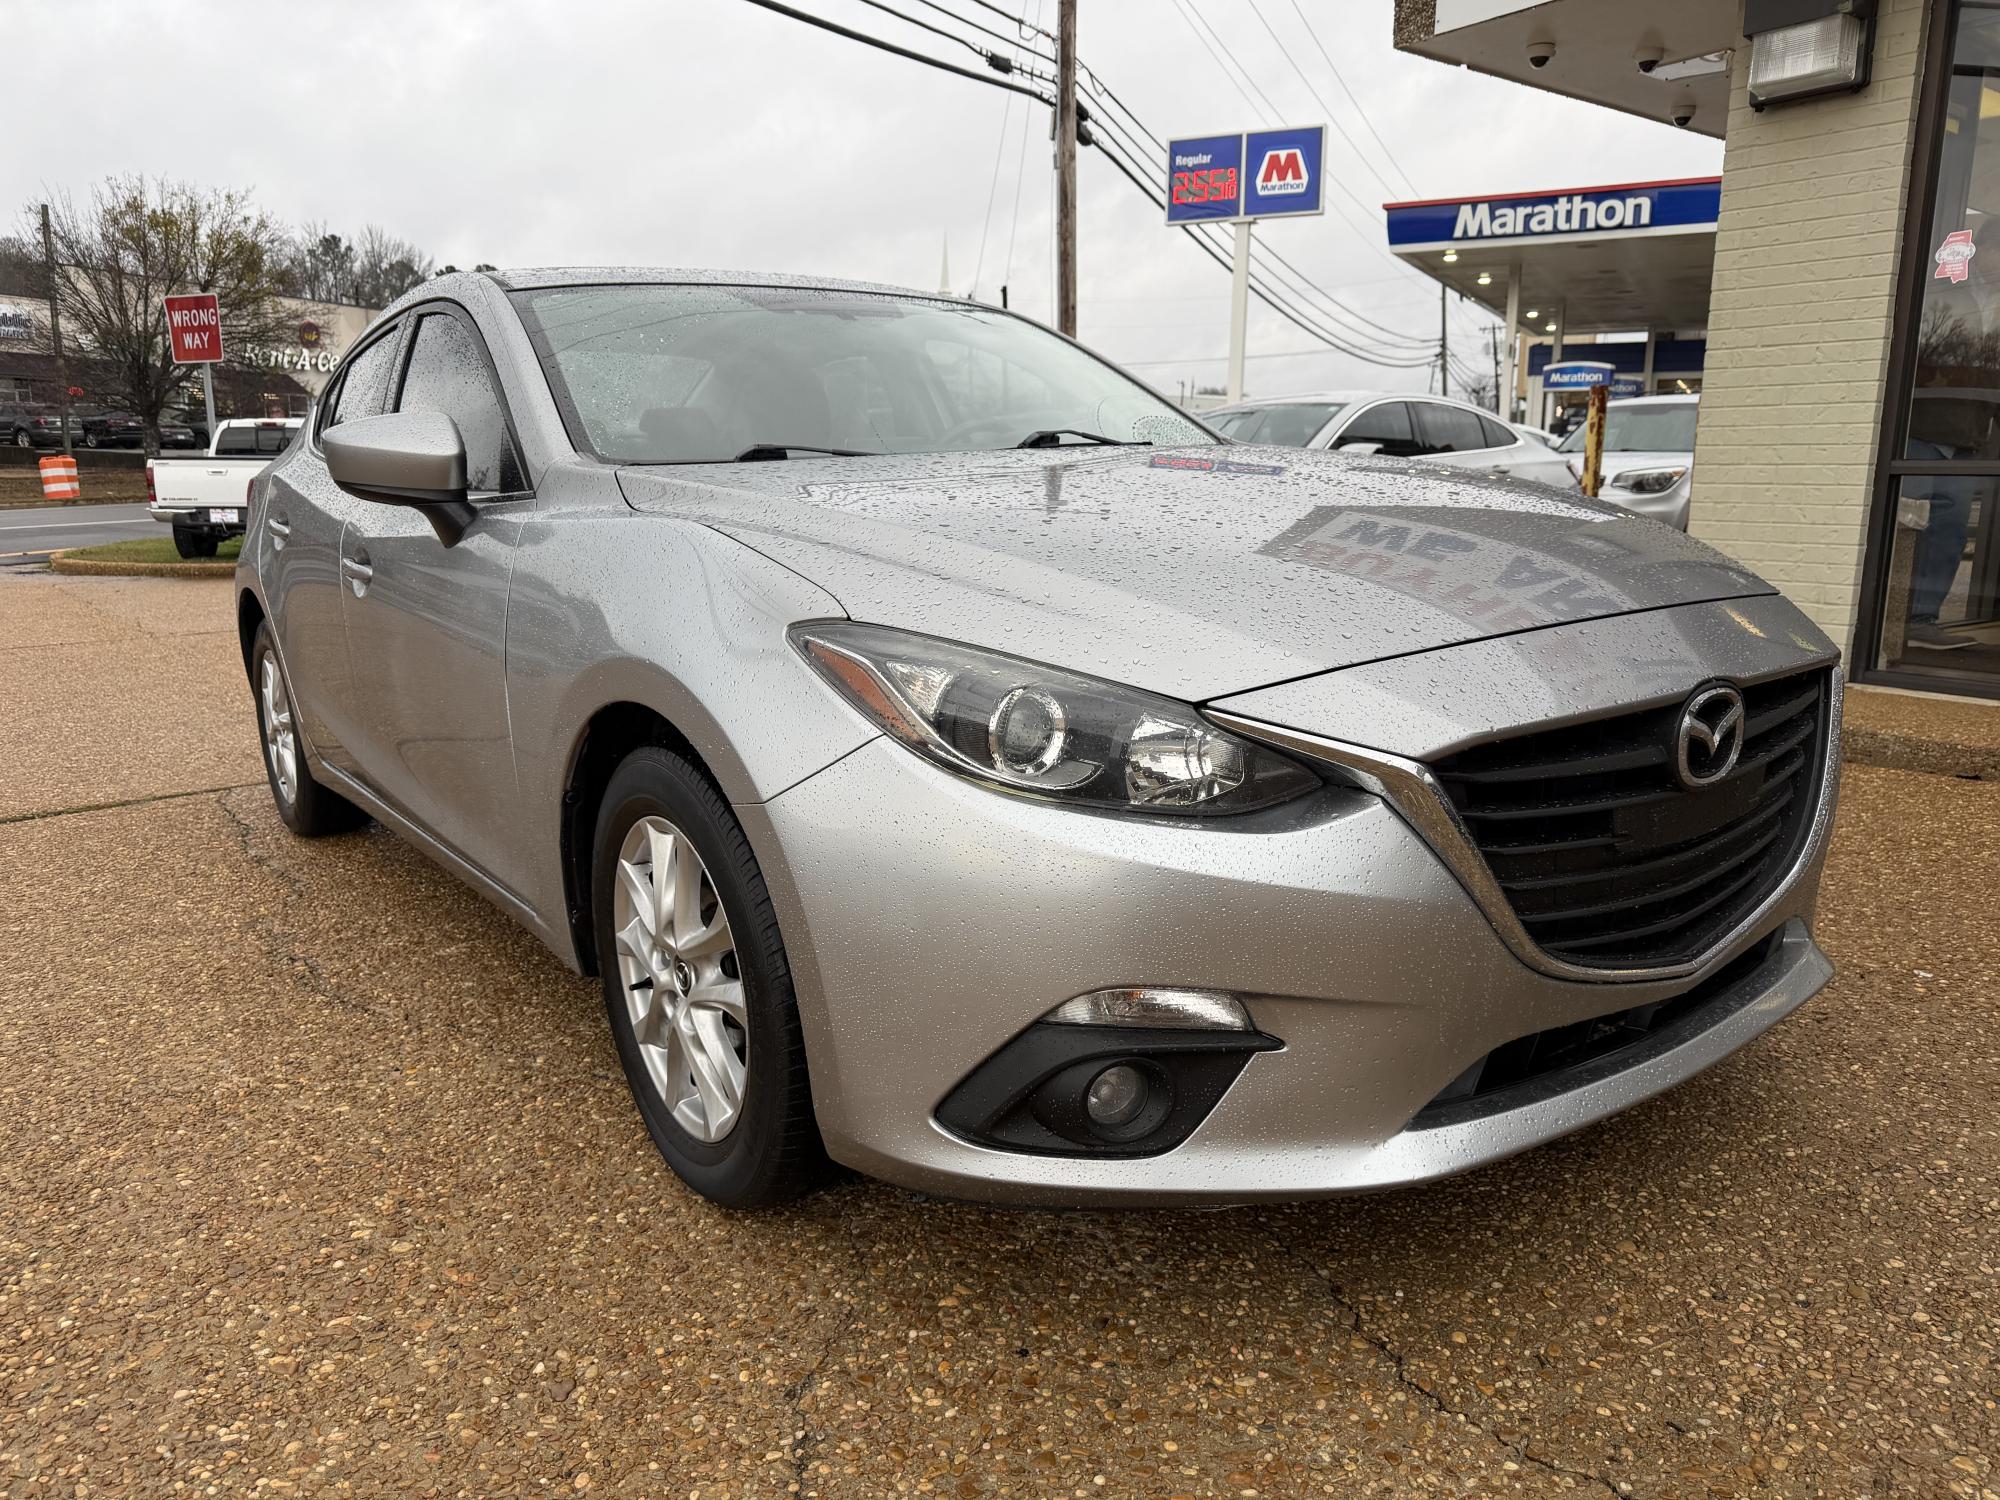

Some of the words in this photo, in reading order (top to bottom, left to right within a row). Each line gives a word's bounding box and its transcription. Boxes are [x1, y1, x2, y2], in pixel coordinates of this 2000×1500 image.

[1175, 153, 1212, 167] Regular
[1260, 181, 1304, 193] Marathon
[1452, 194, 1651, 239] Marathon
[171, 308, 217, 328] WRONG
[183, 331, 209, 350] WAY
[1549, 372, 1603, 383] Marathon
